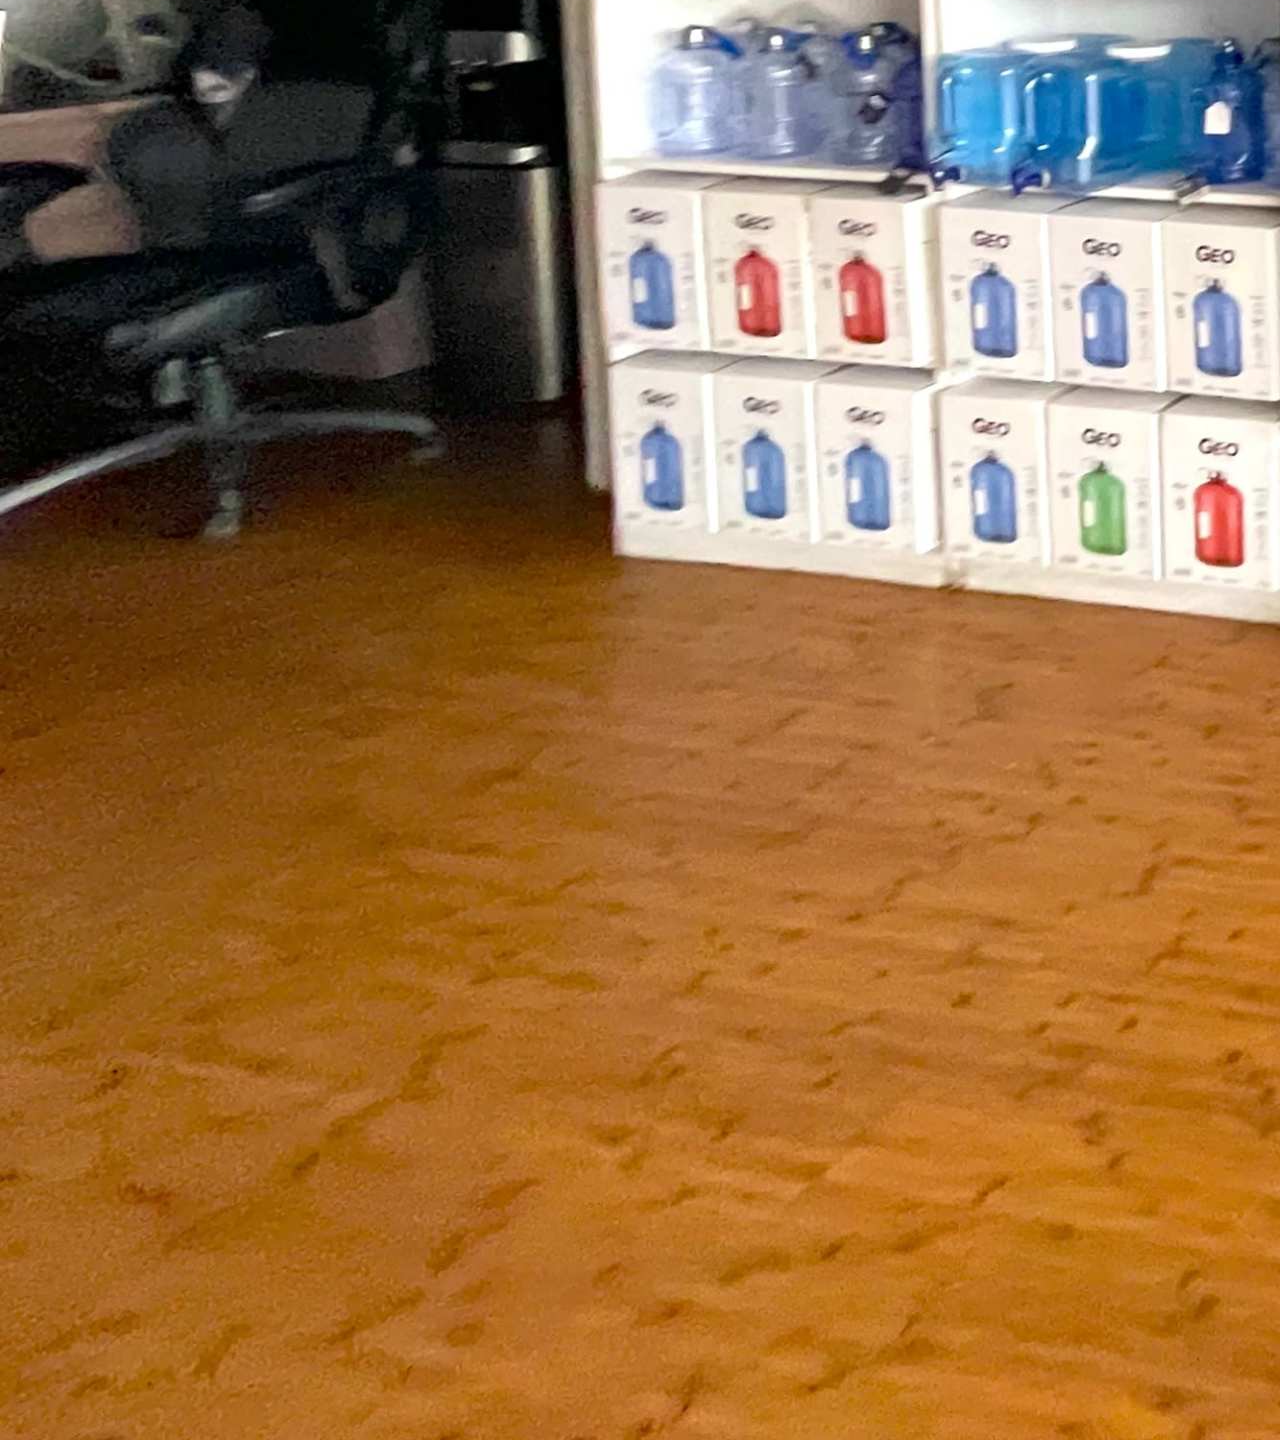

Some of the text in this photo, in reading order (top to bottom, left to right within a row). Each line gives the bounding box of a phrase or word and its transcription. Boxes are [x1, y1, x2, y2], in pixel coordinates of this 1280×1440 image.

[970, 230, 1011, 249] GEO
[1081, 238, 1122, 258] GEO
[1195, 245, 1236, 264] GEO
[971, 417, 1011, 437] GEO
[1081, 428, 1121, 448] GEO
[1198, 438, 1239, 458] GEO
